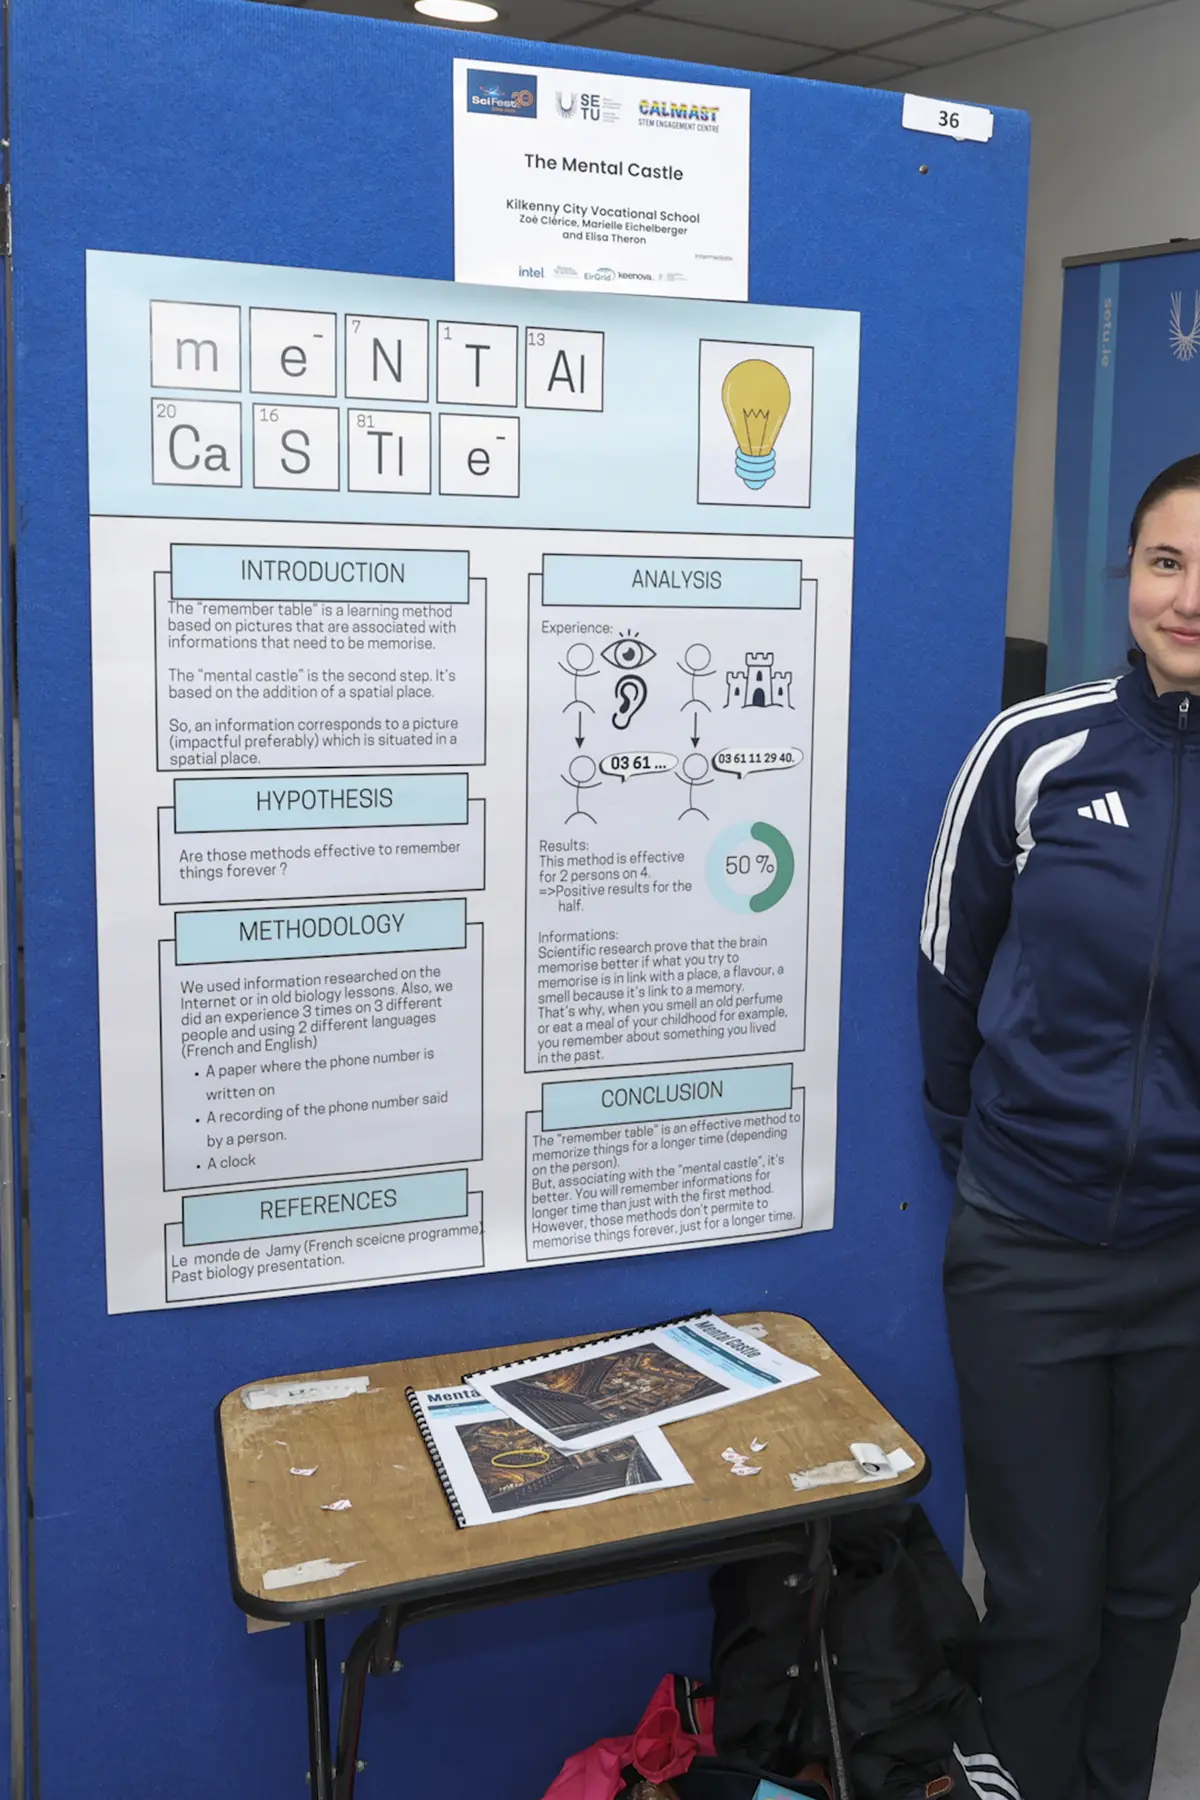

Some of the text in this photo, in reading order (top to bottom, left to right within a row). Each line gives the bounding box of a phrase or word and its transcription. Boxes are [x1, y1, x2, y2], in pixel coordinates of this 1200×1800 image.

[580, 93, 600, 107] SE
[581, 108, 600, 121] TU
[639, 100, 719, 122] CALMAST
[937, 110, 960, 128] 36
[637, 114, 719, 133] STEM ENGAGEMENT CENTRE
[524, 150, 683, 181] The Mental Castle
[505, 196, 700, 223] Kilkenny City Vocational School
[518, 212, 688, 238] Zoé Clérice, Marielle Eichelberger
[561, 228, 647, 244] and Elisa Theron
[518, 266, 544, 279] intel
[584, 272, 612, 282] EirGrid
[352, 321, 361, 334] 7
[527, 332, 546, 346] 13
[174, 336, 219, 373] m
[372, 337, 403, 383] N
[465, 344, 491, 388] T
[156, 404, 376, 428] 20 16 81
[168, 424, 230, 472] Ca
[280, 429, 312, 476] S
[241, 559, 406, 584] INTRODUCTION
[632, 569, 722, 589] ANALYSIS
[167, 600, 194, 614] The
[321, 602, 333, 616] is
[335, 605, 344, 616] a
[346, 602, 399, 620] learning
[401, 603, 453, 618] method
[540, 620, 613, 637] Experience:
[167, 634, 435, 649] informations that need to be memorise.
[168, 668, 194, 682] The
[306, 668, 319, 682] is
[321, 668, 344, 682] the
[347, 668, 397, 682] second
[399, 668, 432, 685] step.
[435, 668, 456, 682] It's
[169, 750, 260, 768] spatial place.
[610, 757, 630, 769] 03
[632, 757, 651, 769] 61
[715, 751, 794, 764] 03 61 11 29 40.
[256, 788, 393, 812] HYPOTHESIS
[178, 839, 460, 863] Are those methods effective to remember
[538, 838, 589, 852] Results:
[539, 849, 685, 867] This method is effective
[725, 855, 775, 875] 50 %
[179, 861, 287, 882] things forever ?
[557, 899, 583, 913] half.
[239, 913, 406, 942] METHODOLOGY
[537, 927, 618, 943] Informations:
[205, 1046, 434, 1080] A paper where the phone number is
[537, 1047, 604, 1064] in the past.
[205, 1084, 275, 1100] written on
[601, 1080, 724, 1108] CONCLUSION
[207, 1153, 256, 1170] A clock
[531, 1165, 547, 1176] on
[549, 1160, 570, 1174] the
[260, 1189, 398, 1220] REFERENCES
[589, 1212, 624, 1228] those
[625, 1206, 677, 1224] methods
[679, 1202, 709, 1218] don't
[710, 1197, 754, 1217] permite
[756, 1196, 769, 1209] to
[171, 1251, 344, 1284] Past biology presentation.
[694, 1320, 734, 1342] Mental
[725, 1338, 762, 1359] Castle
[427, 1390, 482, 1402] Menta
